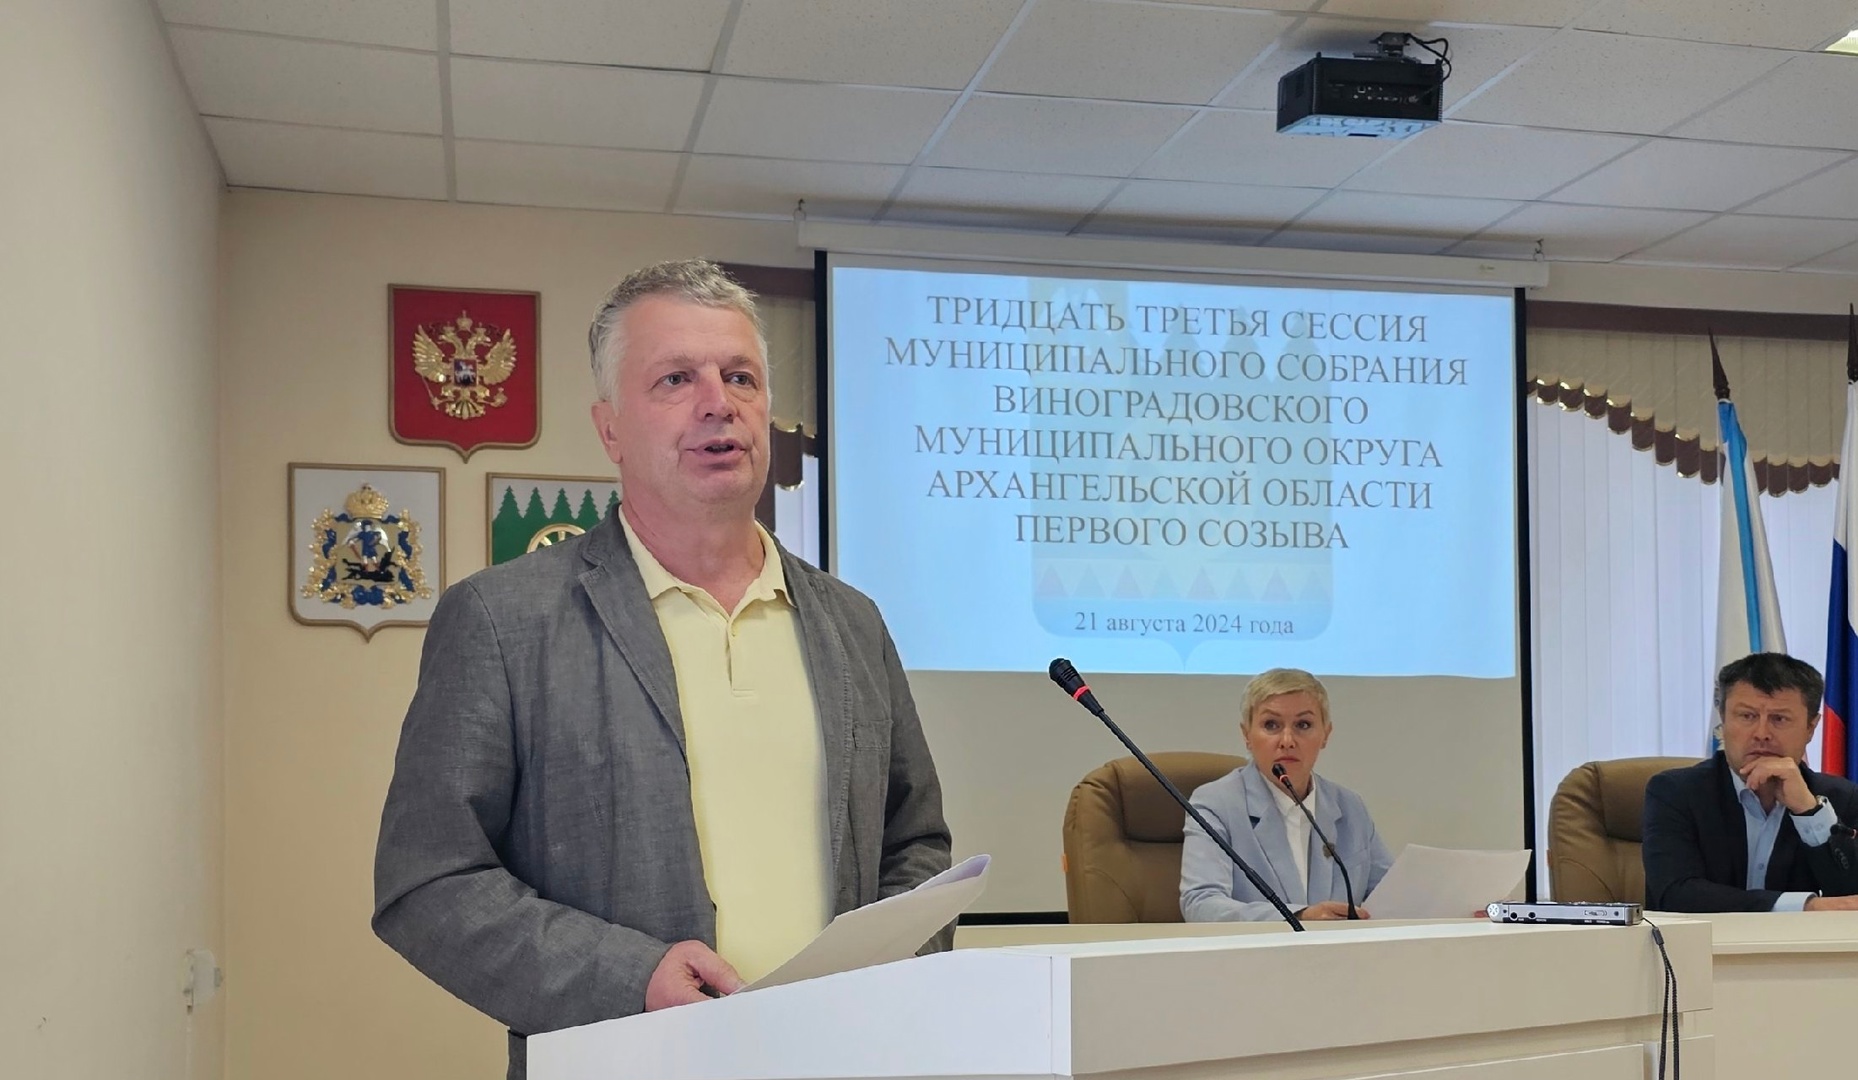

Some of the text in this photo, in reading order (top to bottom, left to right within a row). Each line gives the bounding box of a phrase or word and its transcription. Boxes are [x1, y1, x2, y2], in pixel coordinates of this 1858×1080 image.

[926, 295, 1428, 342] ТРИДЦАТЬ ТРЕТЬЯ СЕССИЯ
[885, 337, 1467, 385] МУНИЦИПАЛЬНОГО СОБРАНИЯ
[994, 385, 1368, 424] ВИНОГРАДОВСКОГО
[914, 425, 1442, 468] МУНИЦИПАЛЬНОГО ОКРУГА
[926, 470, 1432, 509] АРХАНГЕЛЬСКОЙ ОБЛАСТИ
[1015, 515, 1349, 549] ПЕРВОГО СОЗЫВА
[1075, 612, 1293, 636] 21 августа 2024 года
